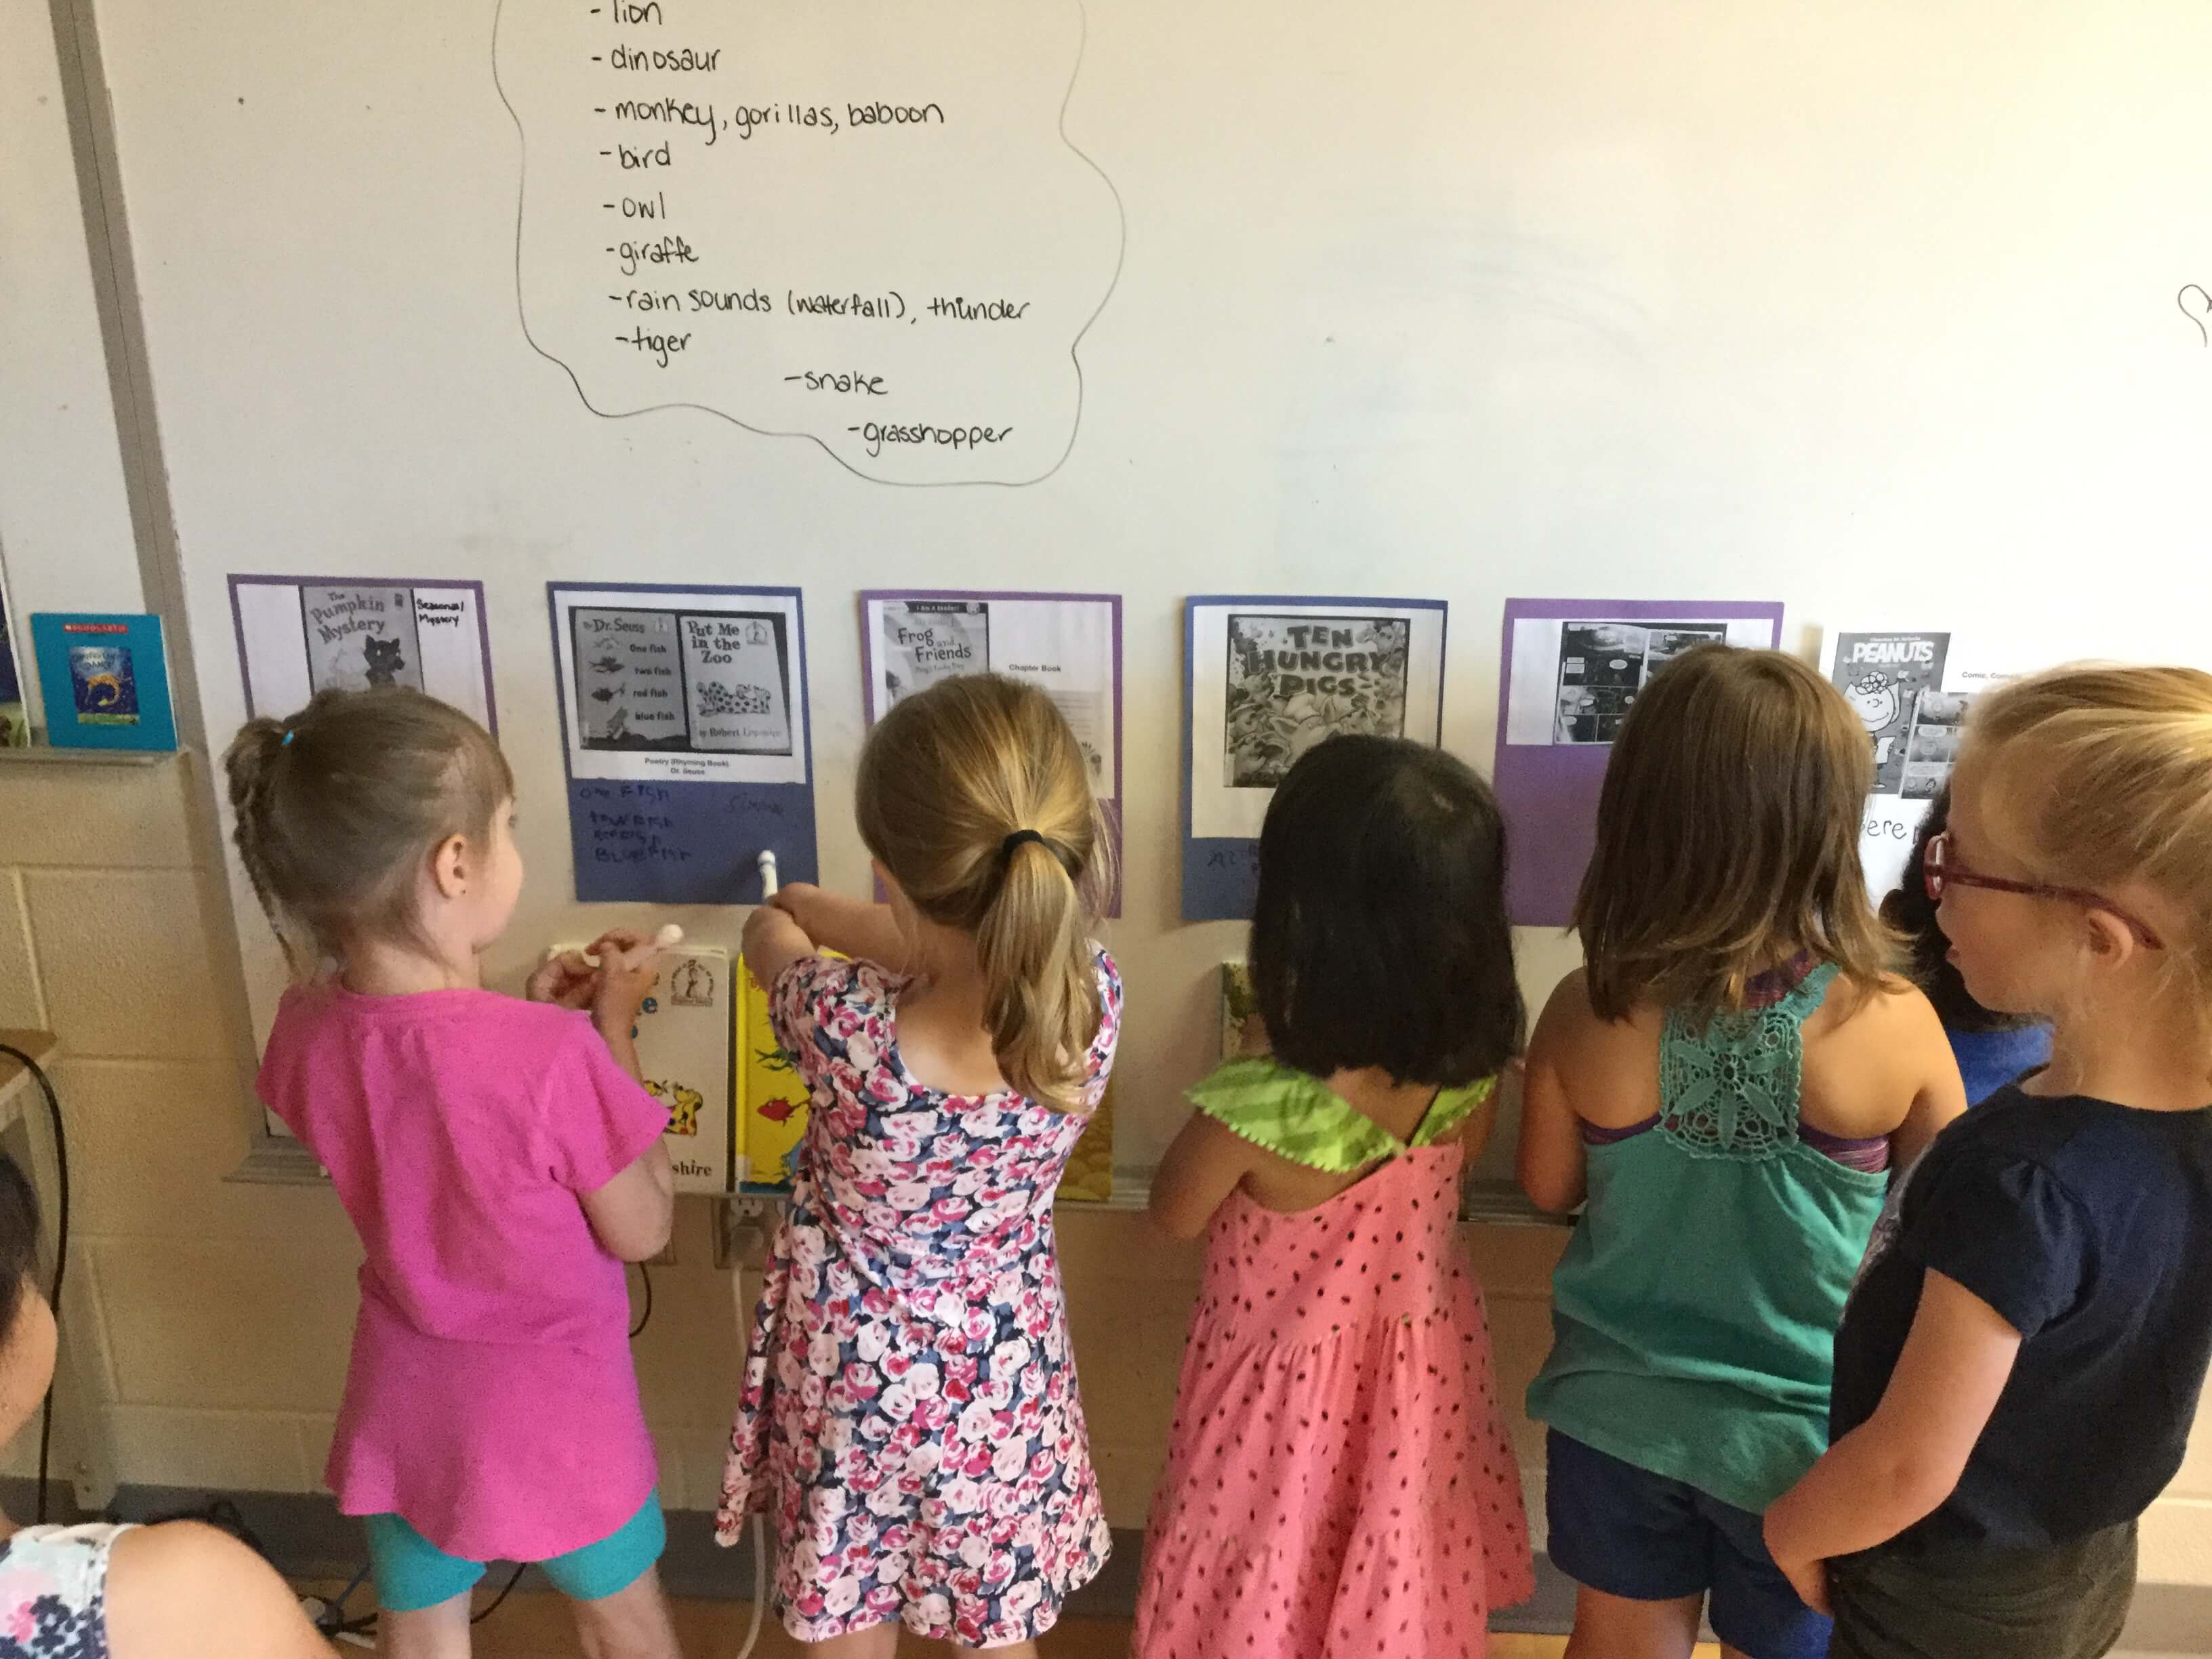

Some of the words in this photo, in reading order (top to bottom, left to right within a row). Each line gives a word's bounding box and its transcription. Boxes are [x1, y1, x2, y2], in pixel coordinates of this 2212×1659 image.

[735, 104, 840, 140] gorillas,
[847, 102, 945, 127] baboon
[688, 288, 773, 312] sounds
[926, 297, 1031, 321] thunder
[310, 594, 384, 625] Pumpkin
[317, 615, 385, 644] Mystery
[593, 619, 613, 632] Dr.
[614, 617, 645, 634] Seuss
[687, 621, 713, 637] Put
[718, 623, 740, 636] Me
[691, 634, 709, 649] in
[713, 636, 741, 651] the
[898, 628, 934, 647] Frog
[937, 636, 956, 647] and
[1288, 626, 1353, 649] TEN
[650, 644, 667, 653] fish
[701, 650, 733, 663] Zoo
[916, 643, 972, 663] Friends
[1852, 641, 1935, 663] PEANUTS
[654, 666, 672, 676] fish
[1247, 650, 1389, 673] HUNGRY
[651, 689, 668, 698] fish
[1279, 674, 1355, 696] PIGS
[657, 712, 675, 721] fish
[1867, 820, 1907, 840] ere
[672, 1160, 712, 1176] shire
